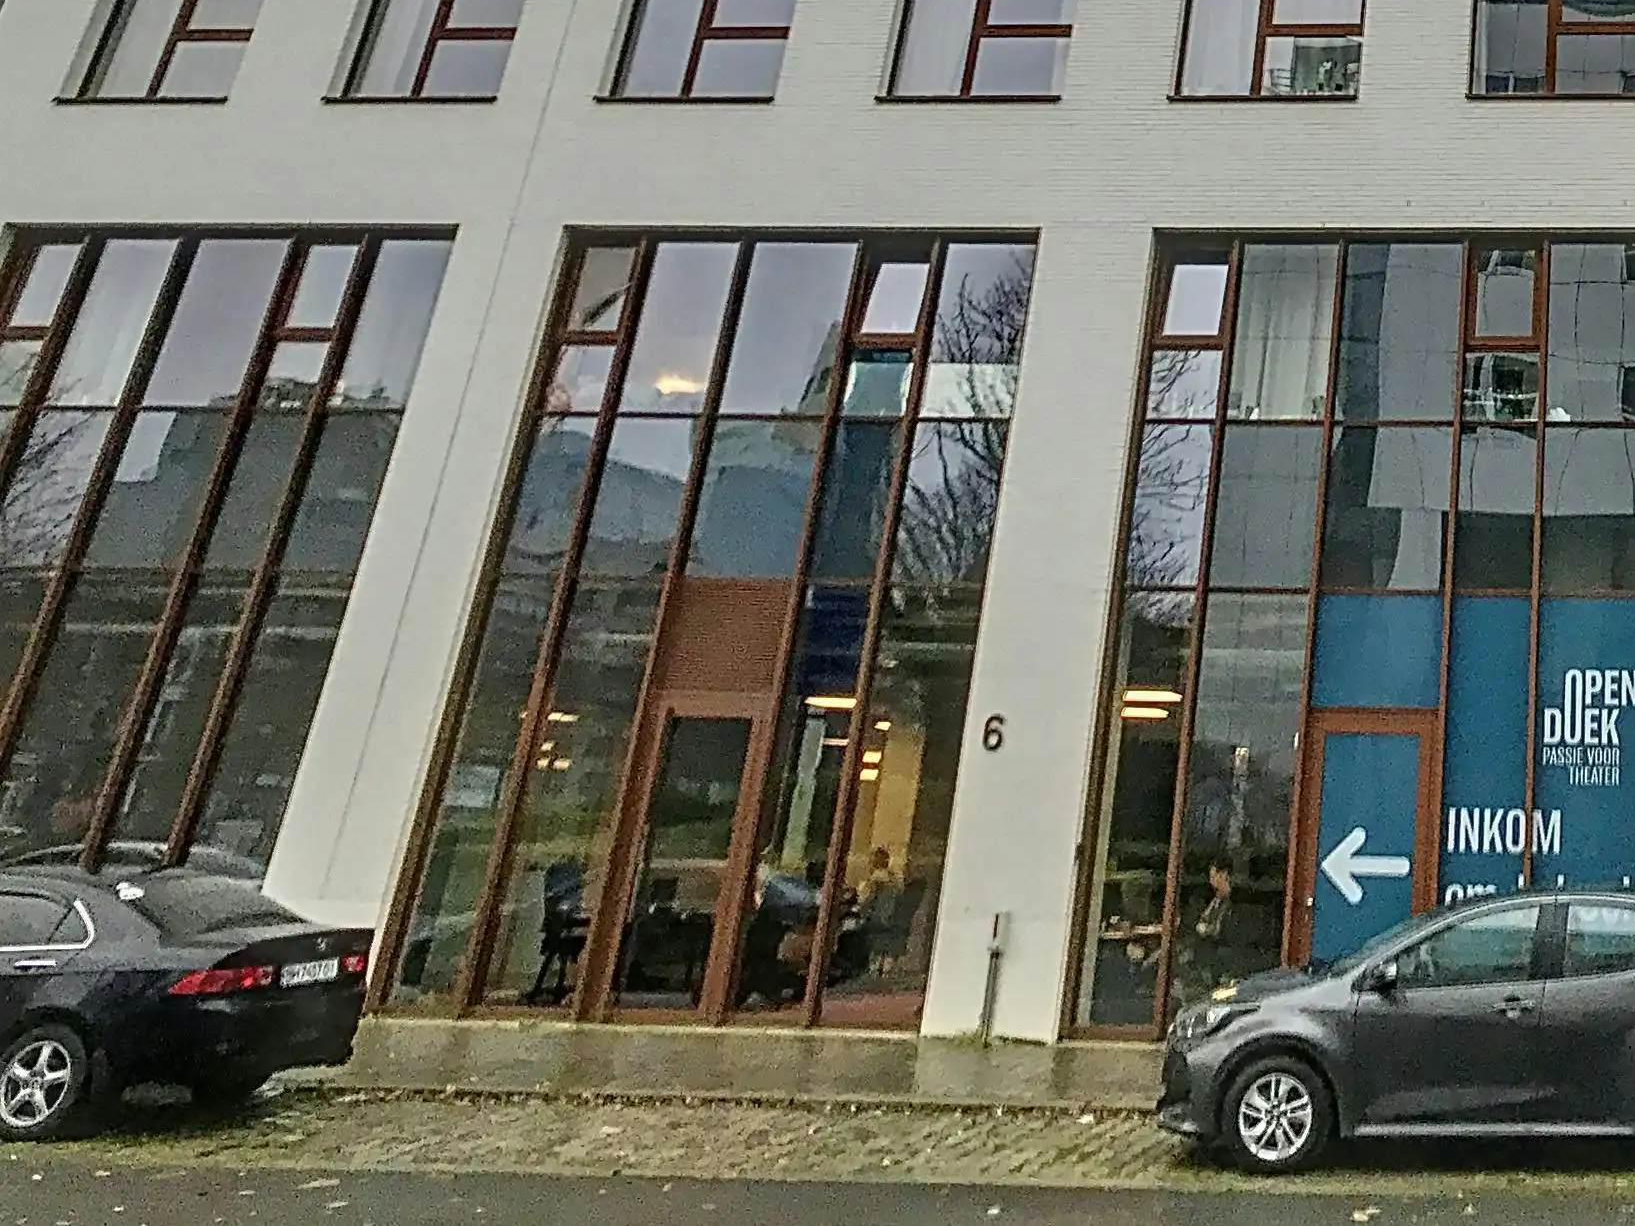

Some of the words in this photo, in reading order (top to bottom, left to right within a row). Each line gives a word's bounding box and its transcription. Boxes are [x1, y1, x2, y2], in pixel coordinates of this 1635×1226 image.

[983, 714, 1004, 752] 6
[1542, 746, 1584, 766] PASSIE
[1587, 746, 1620, 766] VOOR
[1569, 765, 1620, 787] THEATER
[1447, 806, 1562, 856] INKOM
